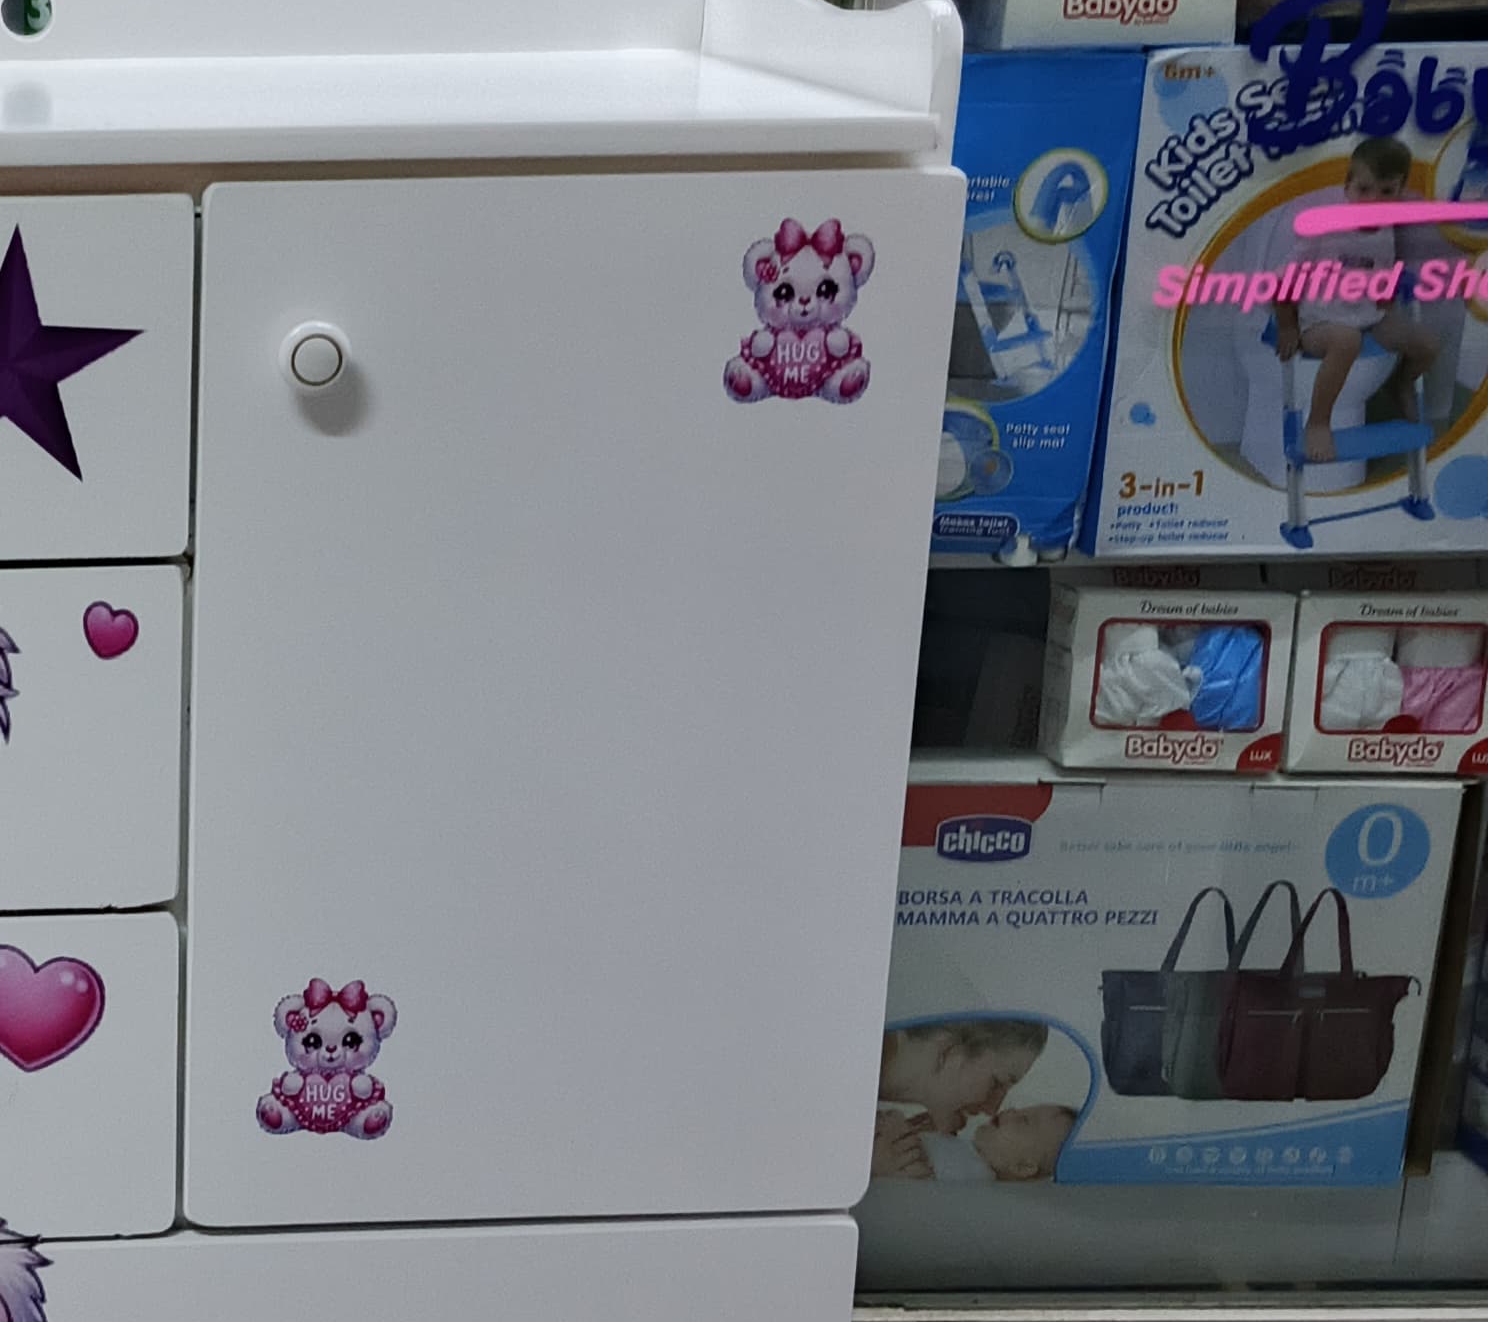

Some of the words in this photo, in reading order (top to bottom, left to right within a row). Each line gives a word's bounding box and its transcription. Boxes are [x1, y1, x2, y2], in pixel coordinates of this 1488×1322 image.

[1146, 106, 1241, 191] Kids
[1146, 139, 1255, 239] Toilet
[1153, 260, 1404, 314] Simplified
[777, 340, 821, 364] HUG
[783, 366, 811, 384] ME
[1118, 469, 1206, 501] 3-in-1
[1140, 600, 1183, 615] Dream
[1360, 603, 1404, 617] Dream
[1124, 733, 1223, 764] Babydo
[1248, 749, 1273, 762] LUX
[1347, 738, 1445, 766] Babydo
[942, 823, 1026, 854] chicco
[898, 889, 963, 906] BORSA
[969, 889, 983, 905] A
[990, 889, 1089, 906] TRACOLLA
[896, 910, 980, 927] MAMMA
[986, 910, 1000, 926] A
[1005, 909, 1098, 928] QUATTRO
[1105, 909, 1158, 926] PEZZI
[305, 1083, 346, 1103] HUG
[311, 1104, 337, 1120] ME
